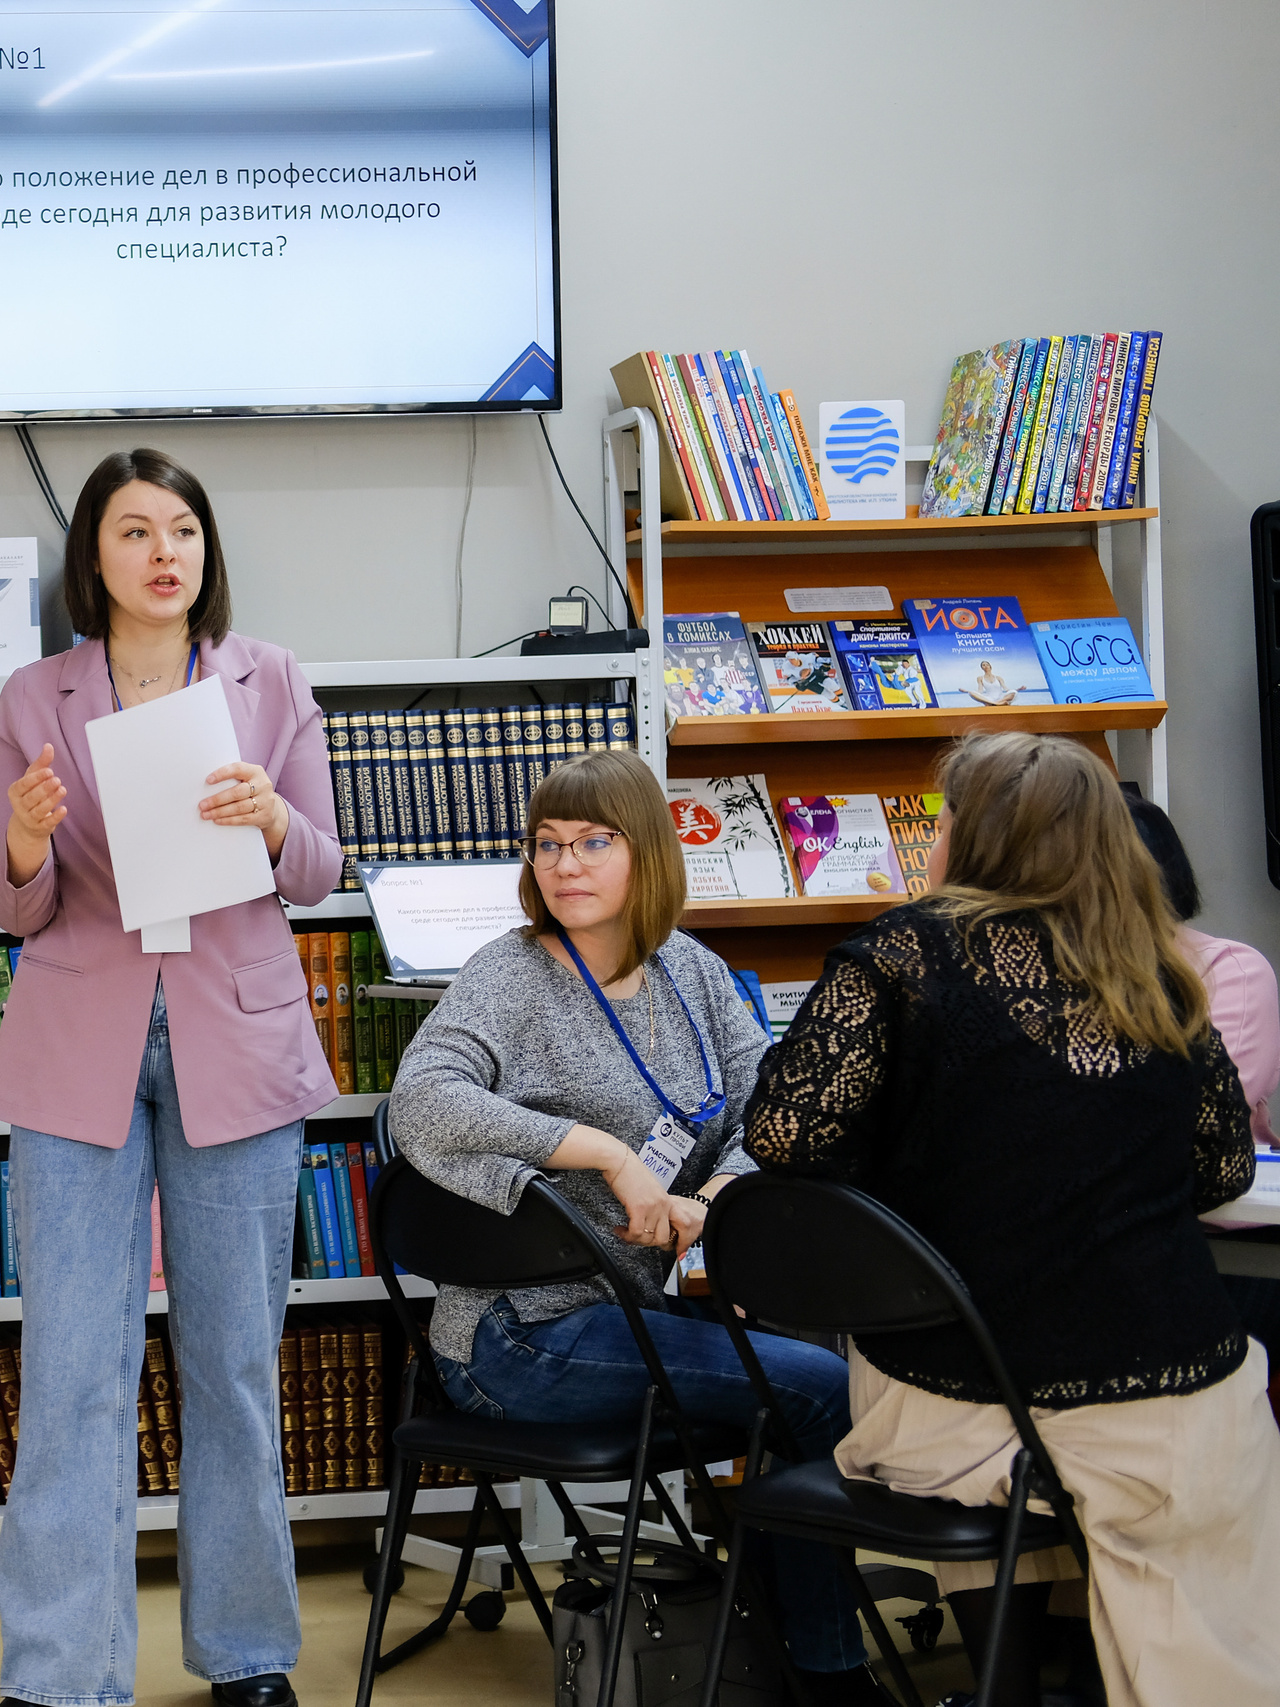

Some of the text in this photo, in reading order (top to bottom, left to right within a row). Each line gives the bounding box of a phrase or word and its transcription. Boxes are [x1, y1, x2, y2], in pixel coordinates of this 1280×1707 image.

[0, 47, 45, 70] №1
[14, 169, 154, 187] положение
[163, 169, 206, 189] дел
[217, 169, 227, 184] в
[238, 160, 476, 188] профессиональной
[41, 207, 137, 227] сегодня
[147, 206, 190, 226] для
[201, 204, 311, 225] развития
[321, 203, 440, 222] молодого
[117, 236, 287, 262] специалиста?
[993, 394, 1008, 433] МИРОВЫЕ
[1040, 340, 1074, 491] ГИННЕСС МИРОВЫЕ РЕКОРДЫ 2015
[1057, 341, 1086, 469] ГИННЕСС МИРОВЫЕ РЕКОРДЫ
[1096, 336, 1129, 491] ГИННЕСС МИРОВЫЕ РЕКОРДЫ 2005
[1128, 337, 1160, 484] КНИГА РЕКОРДОВ ГИННЕССА
[995, 353, 1032, 494] ГИННЕСС РЕКОРДЫ 2019
[794, 415, 818, 482] ПОКАЖИ МНЕ КАК
[984, 434, 998, 472] РЕКОРДЫ
[980, 472, 990, 491] 2021
[677, 622, 716, 632] ФУТБОЛ
[922, 604, 1018, 631] ЙОГА
[1054, 621, 1091, 630] Кристин
[667, 632, 732, 643] В КОМИКСАХ
[757, 624, 825, 645] ХОККЕЙ
[850, 632, 910, 643] ДЖИУ-ДЖИТСУ
[1061, 666, 1137, 677] между делом
[885, 795, 928, 818] КАК
[676, 805, 714, 840] 美
[802, 837, 884, 853] OK English
[643, 1154, 670, 1178] ЮЛИЯ
[647, 1145, 677, 1169] УЧАСТНИК
